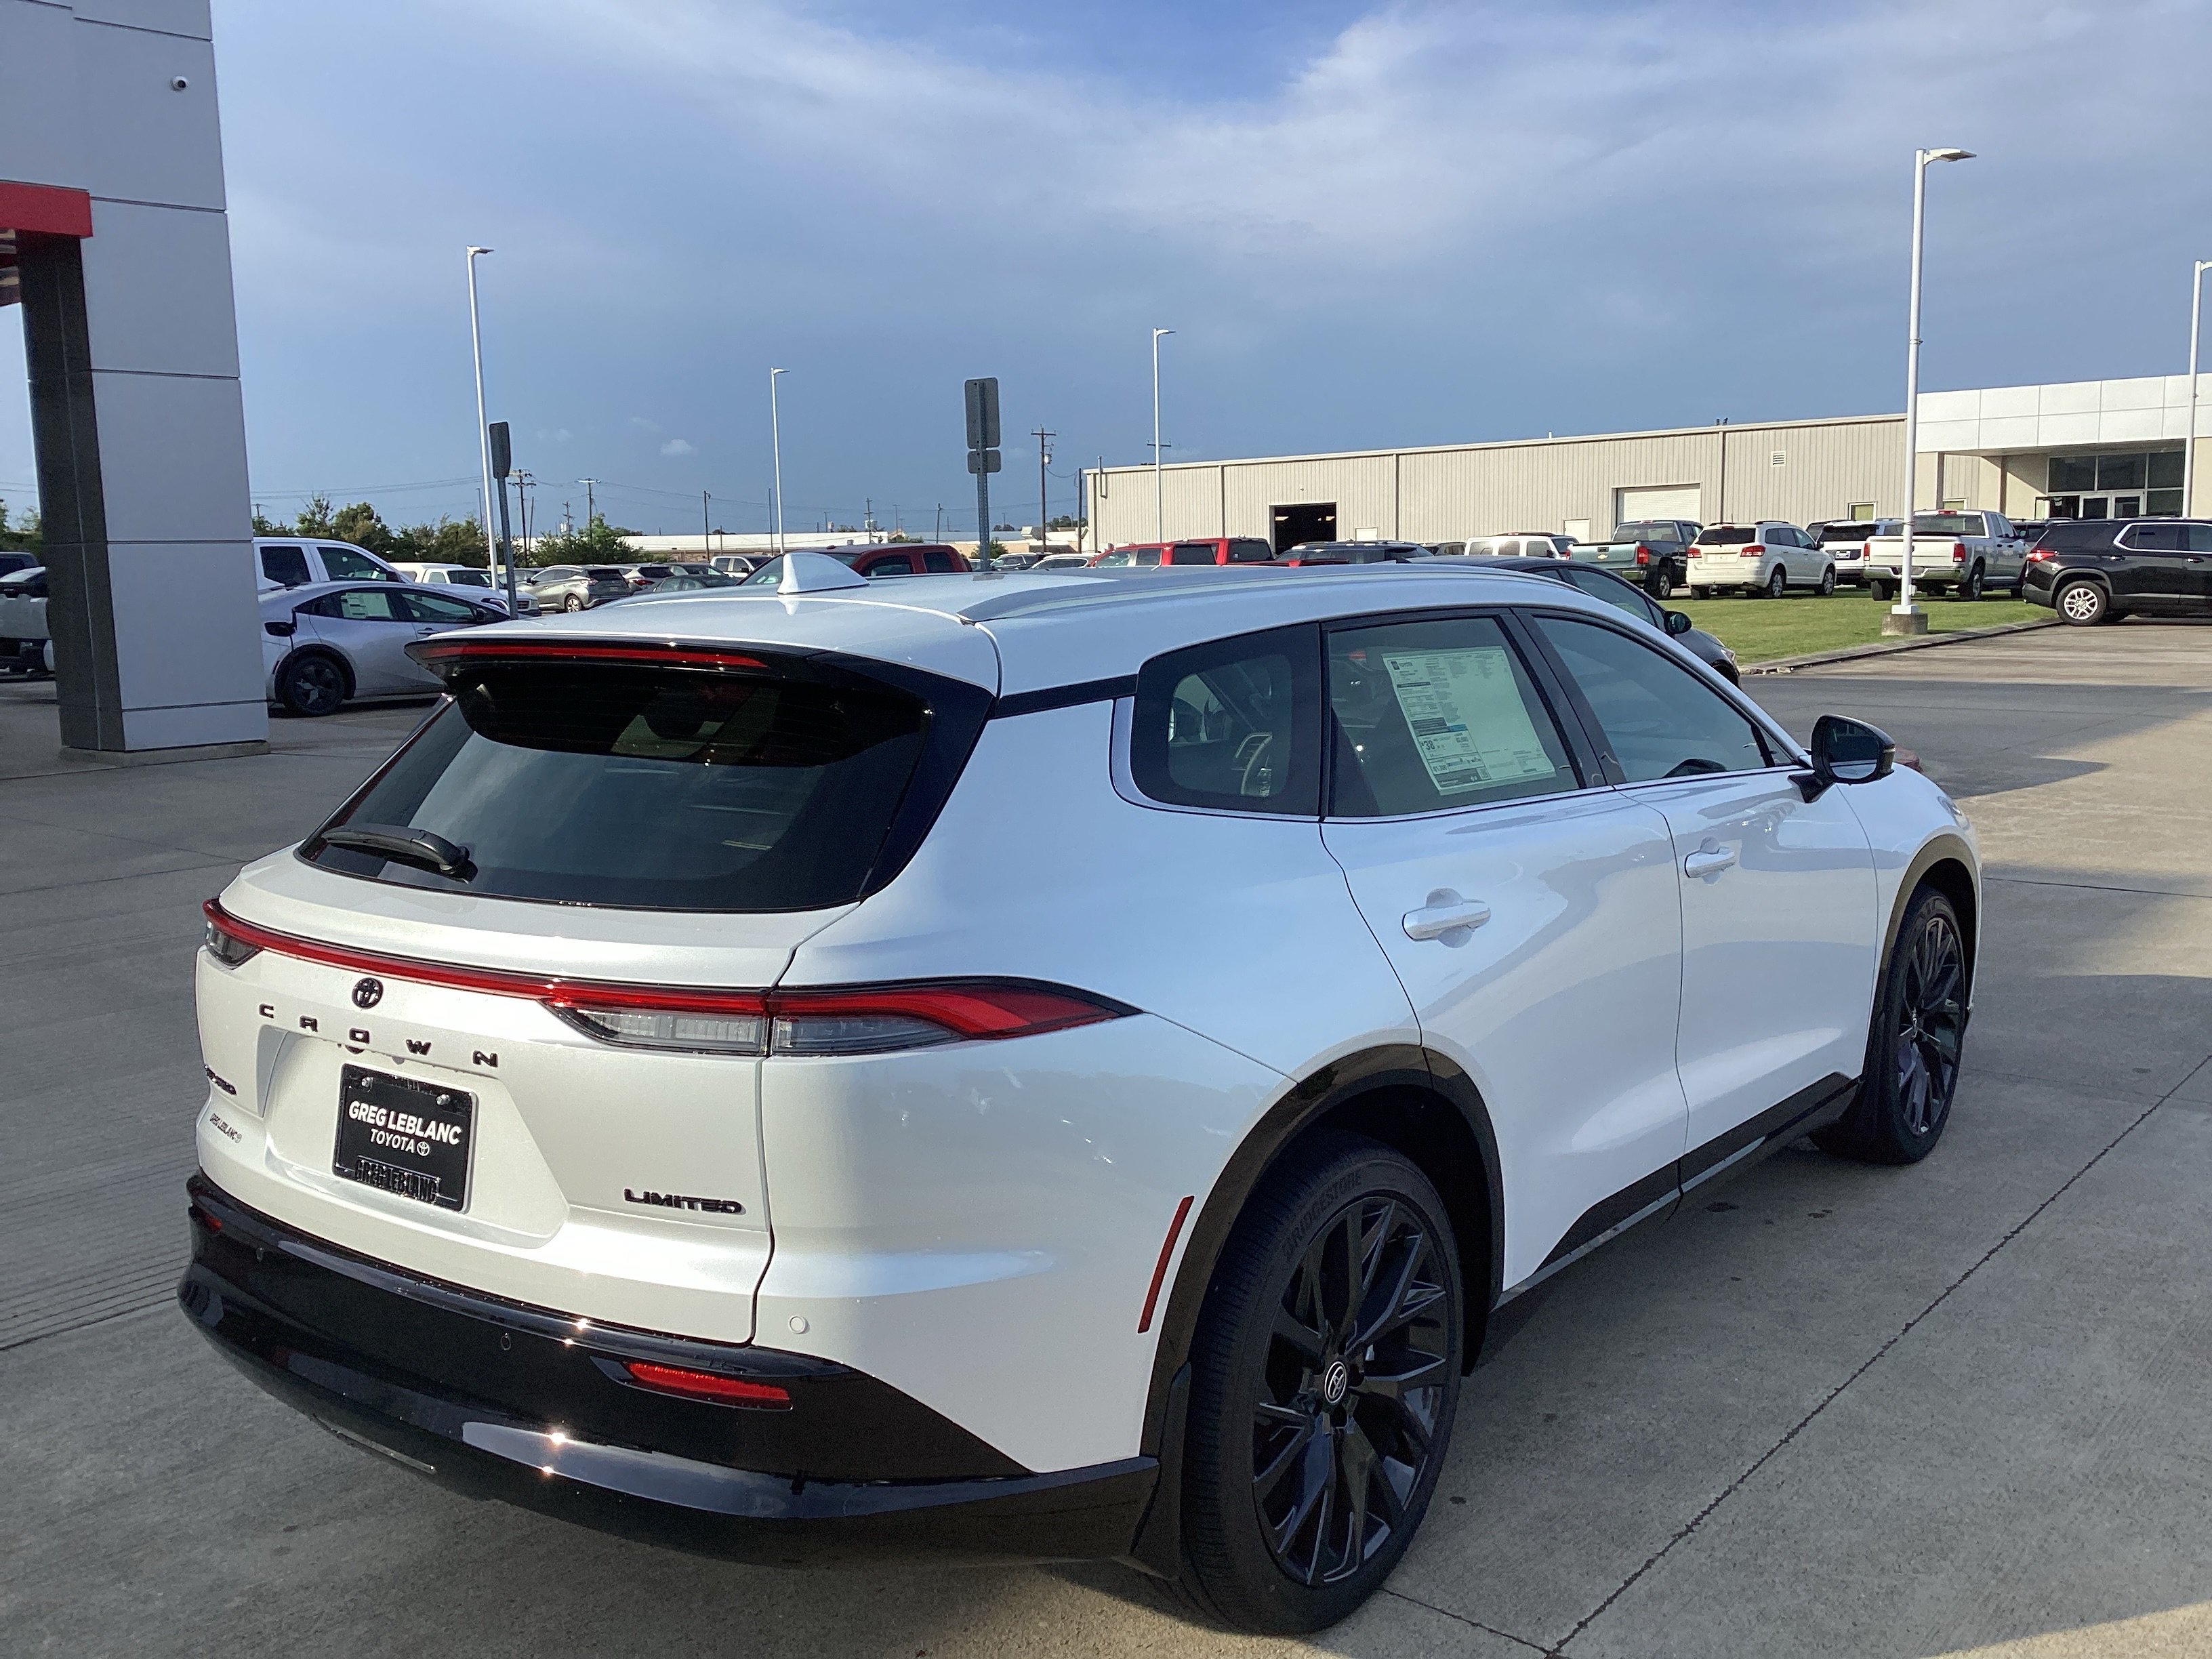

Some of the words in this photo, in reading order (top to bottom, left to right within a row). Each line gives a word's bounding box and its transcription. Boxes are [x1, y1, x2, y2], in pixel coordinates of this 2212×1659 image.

[259, 1003, 498, 1068] CROWN
[348, 1100, 387, 1126] GREG
[387, 1110, 462, 1145] LEBLANC
[370, 1128, 415, 1153] TOYOTA
[623, 1188, 744, 1214] LIMITED
[1282, 1168, 1363, 1263] BRIDGESTONE
